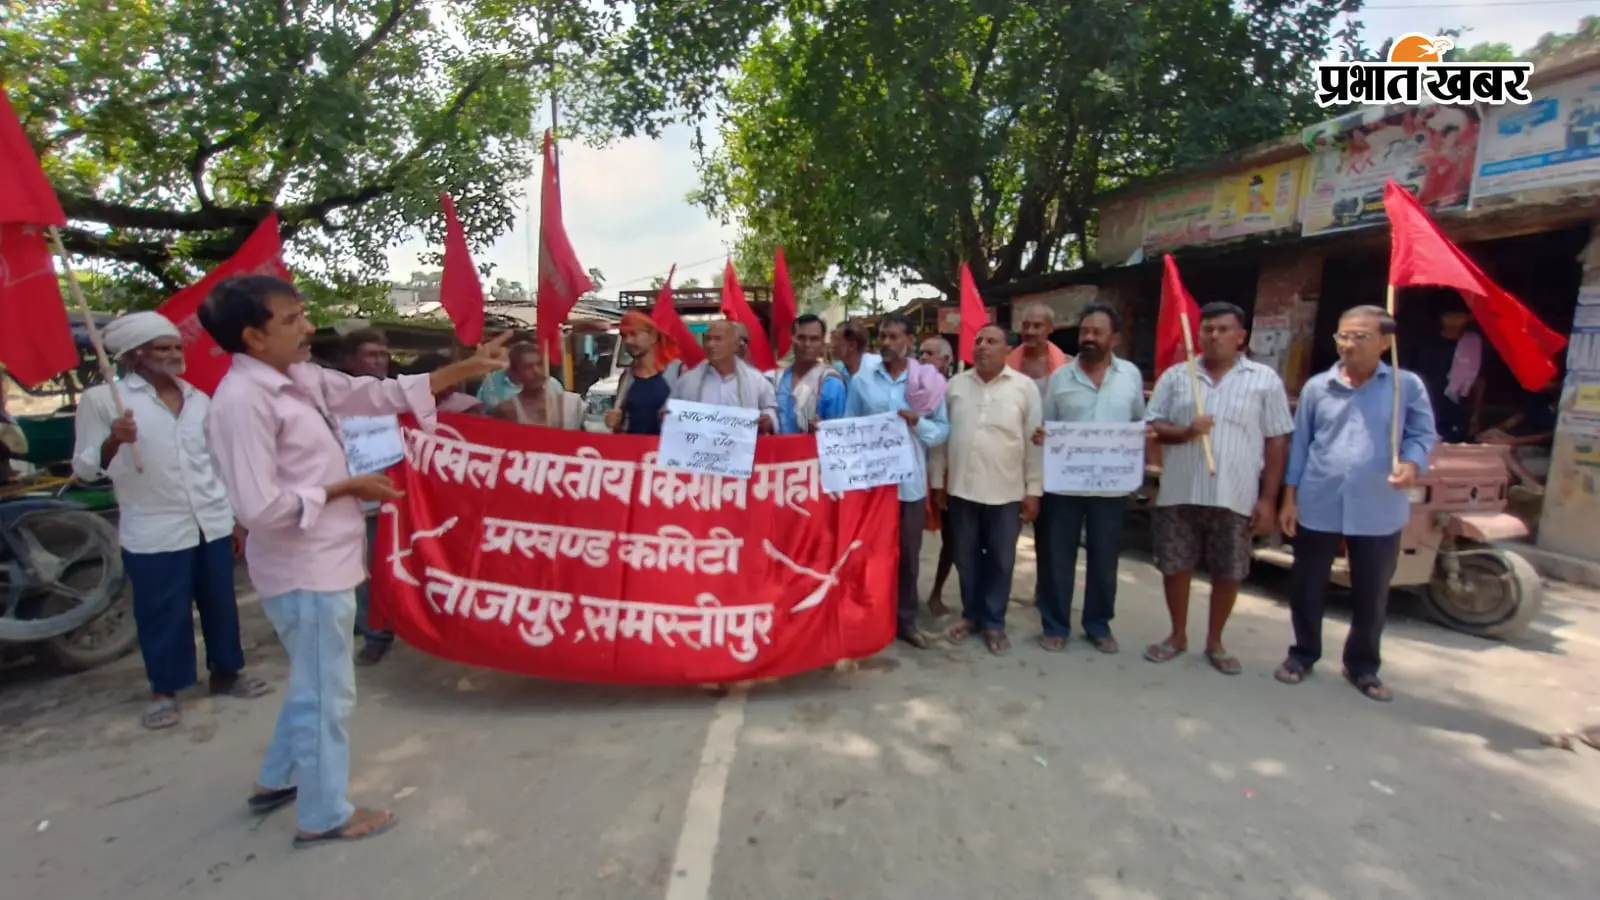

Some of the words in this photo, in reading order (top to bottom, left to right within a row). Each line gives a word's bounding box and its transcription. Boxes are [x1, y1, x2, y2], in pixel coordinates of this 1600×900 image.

[504, 446, 636, 504] भारतीय
[481, 517, 616, 568] प्रखण्ड
[618, 524, 744, 576] कमिटी
[582, 592, 775, 662] समस्तीपुर
